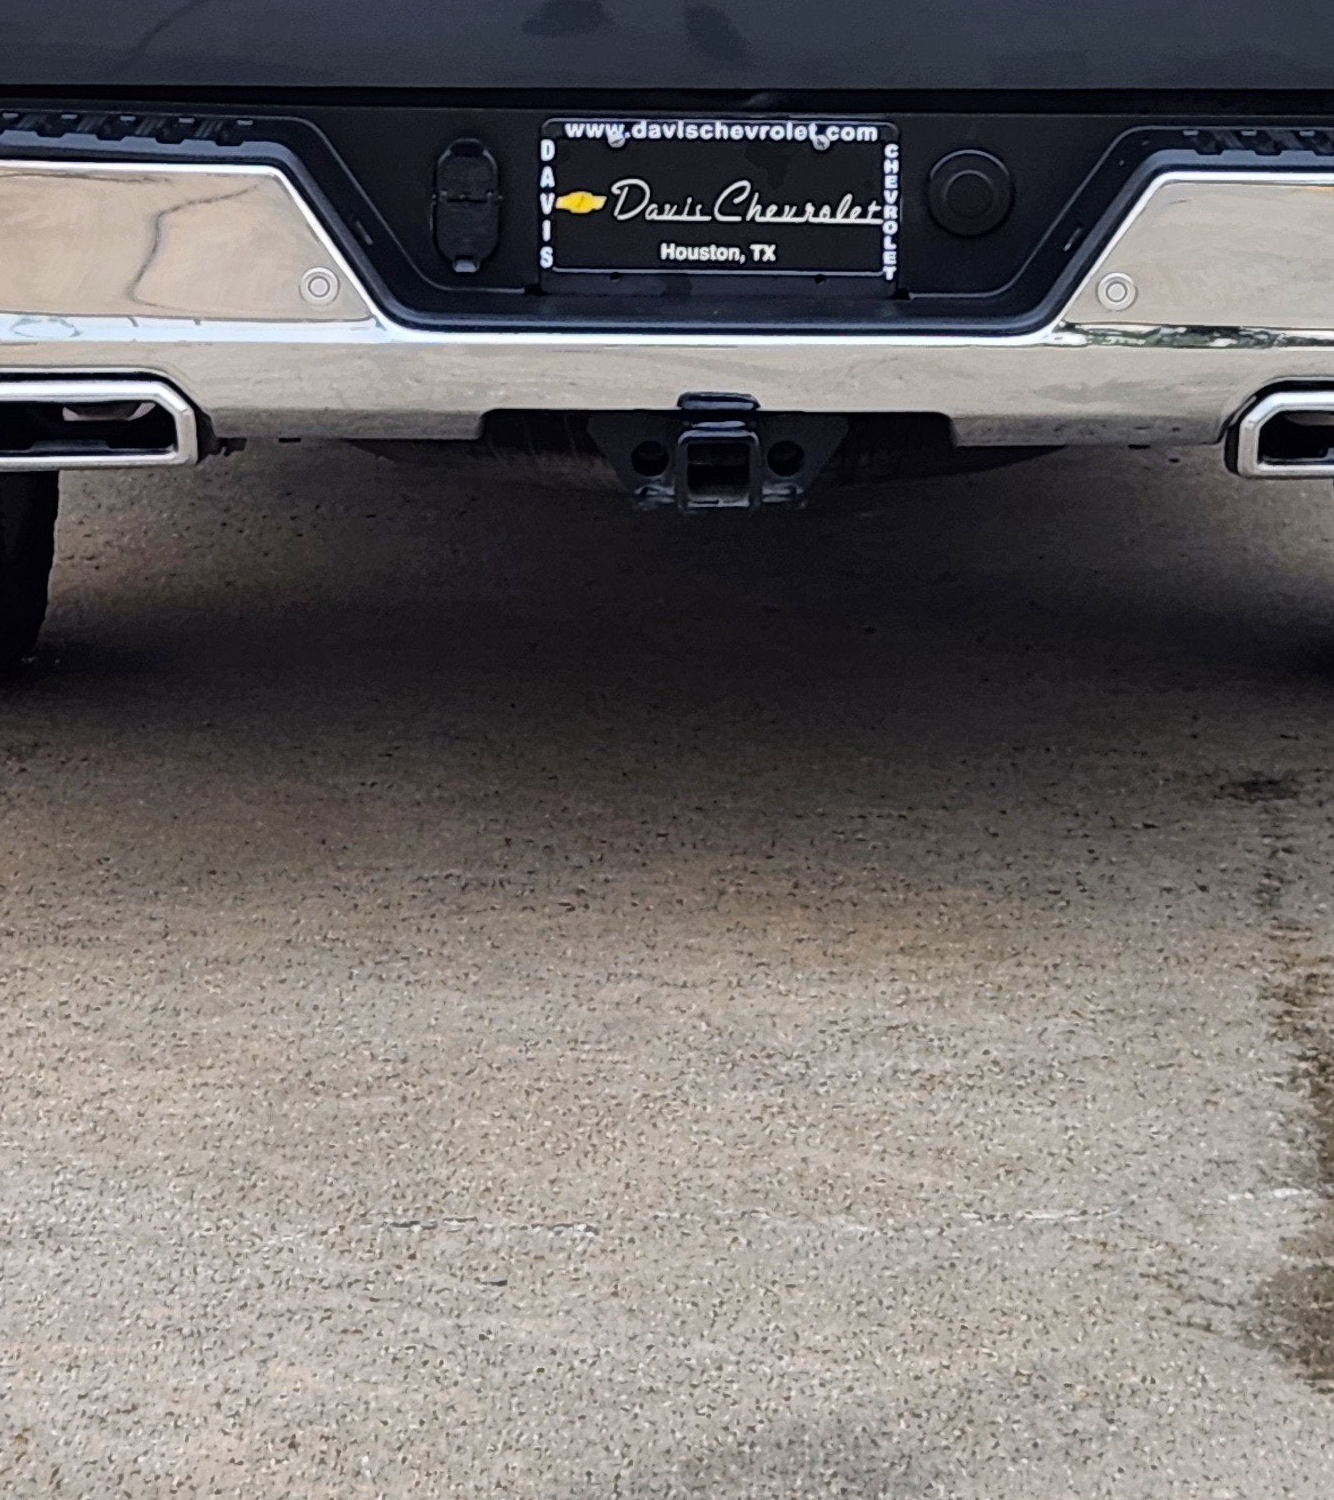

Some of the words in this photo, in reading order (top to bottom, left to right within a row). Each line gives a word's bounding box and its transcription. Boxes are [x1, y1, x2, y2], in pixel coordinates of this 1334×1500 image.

[564, 120, 879, 142] www.davischevrolet.com
[539, 138, 556, 269] DAVIS
[611, 178, 712, 221] Davis
[714, 180, 884, 225] Chevrolet
[882, 143, 900, 281] CHEVROLET
[660, 242, 746, 264] Houston,
[750, 244, 777, 262] TX
